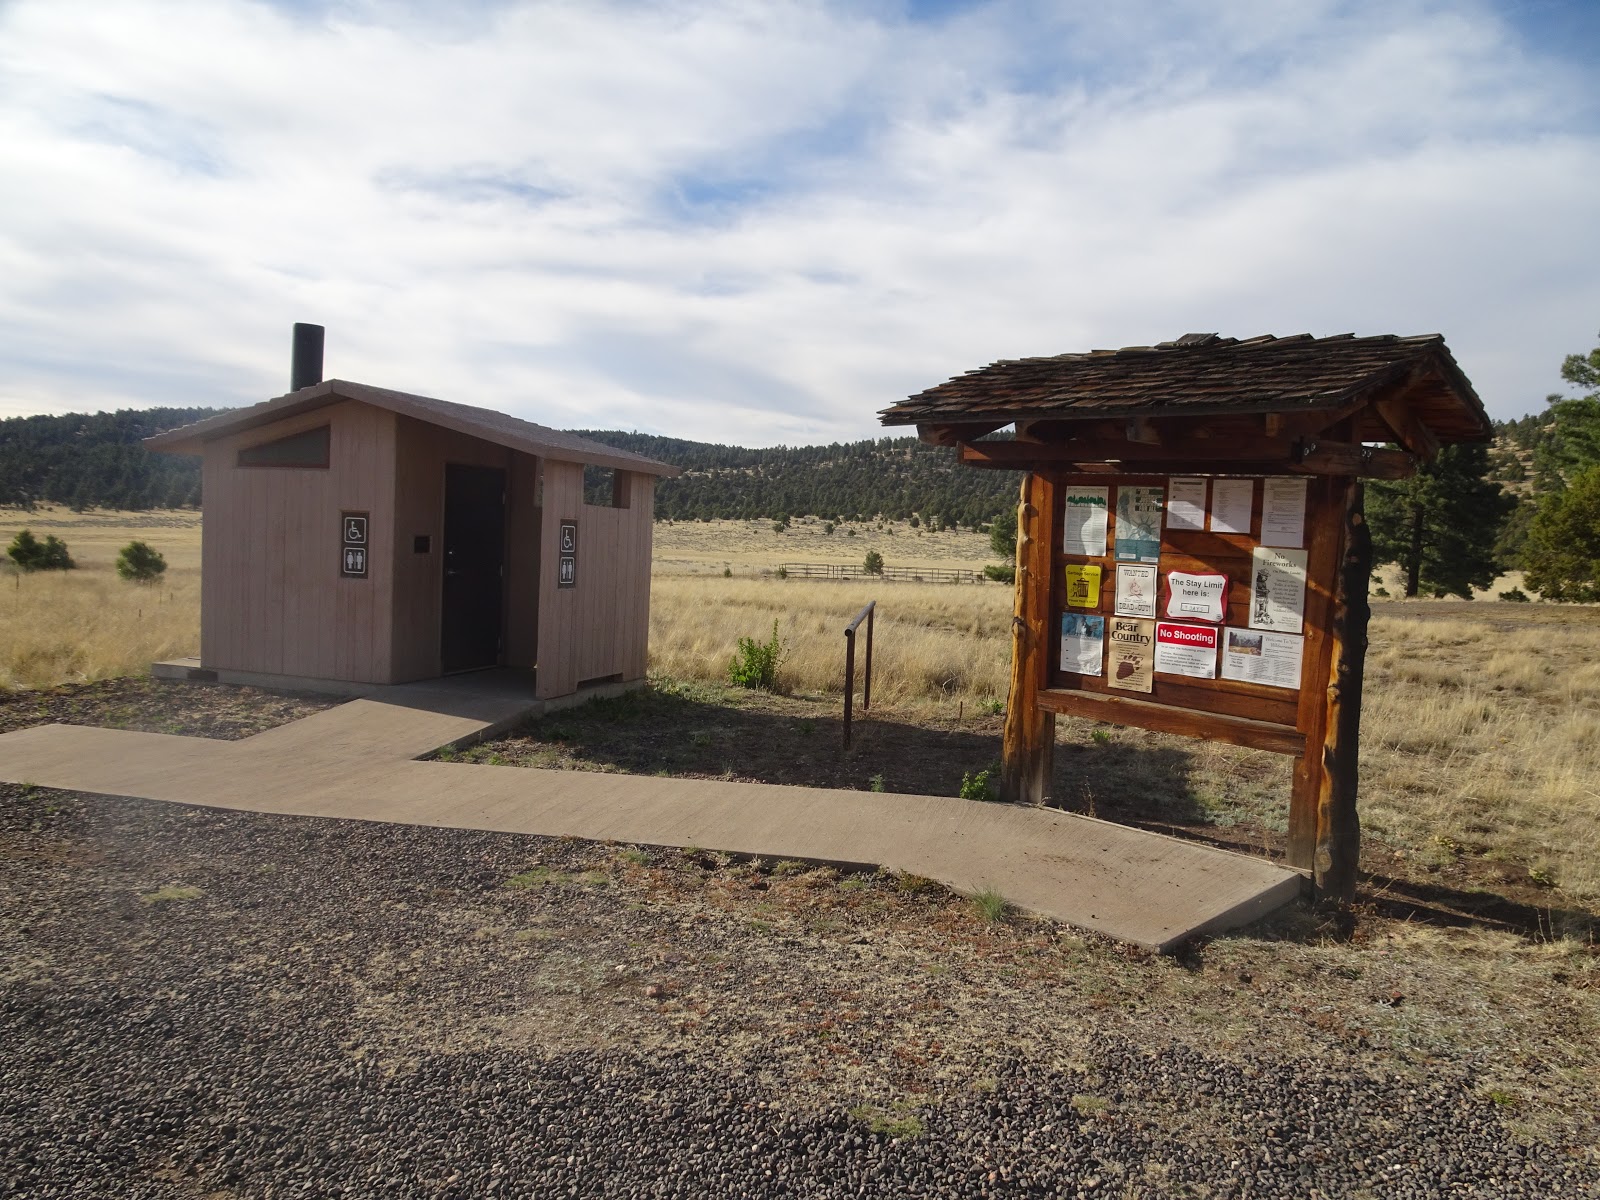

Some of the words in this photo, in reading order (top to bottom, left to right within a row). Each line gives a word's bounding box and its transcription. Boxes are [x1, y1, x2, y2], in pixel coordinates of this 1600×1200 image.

[1262, 560, 1296, 568] Fireworks
[1124, 569, 1149, 578] WANTED
[1186, 580, 1202, 588] Stay
[1116, 622, 1138, 632] Bear
[1111, 630, 1151, 646] Country
[1160, 629, 1172, 638] No
[1174, 630, 1214, 644] Shooting
